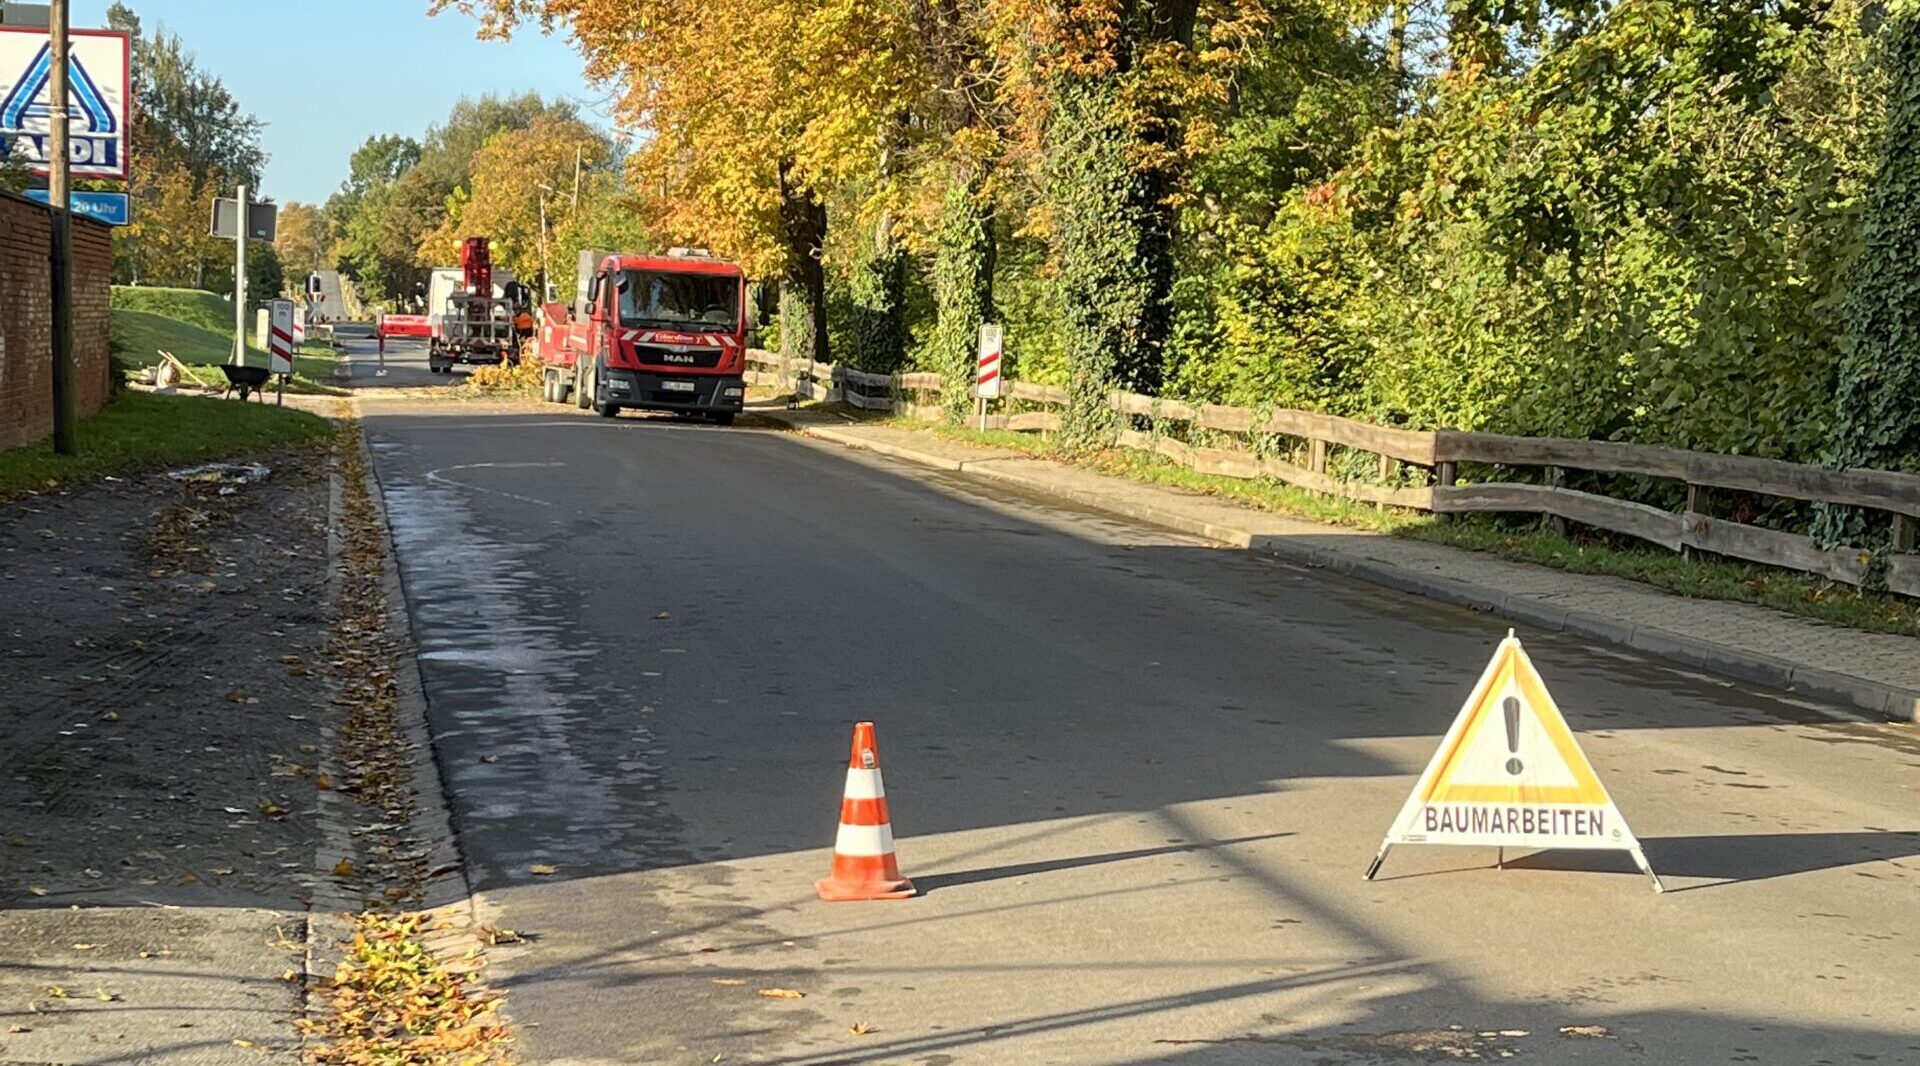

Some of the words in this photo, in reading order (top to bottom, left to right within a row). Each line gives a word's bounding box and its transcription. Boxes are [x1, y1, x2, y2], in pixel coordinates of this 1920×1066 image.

[92, 202, 118, 214] Uhr
[663, 354, 694, 363] MAN
[1425, 806, 1604, 836] BAUMARBEITEN
